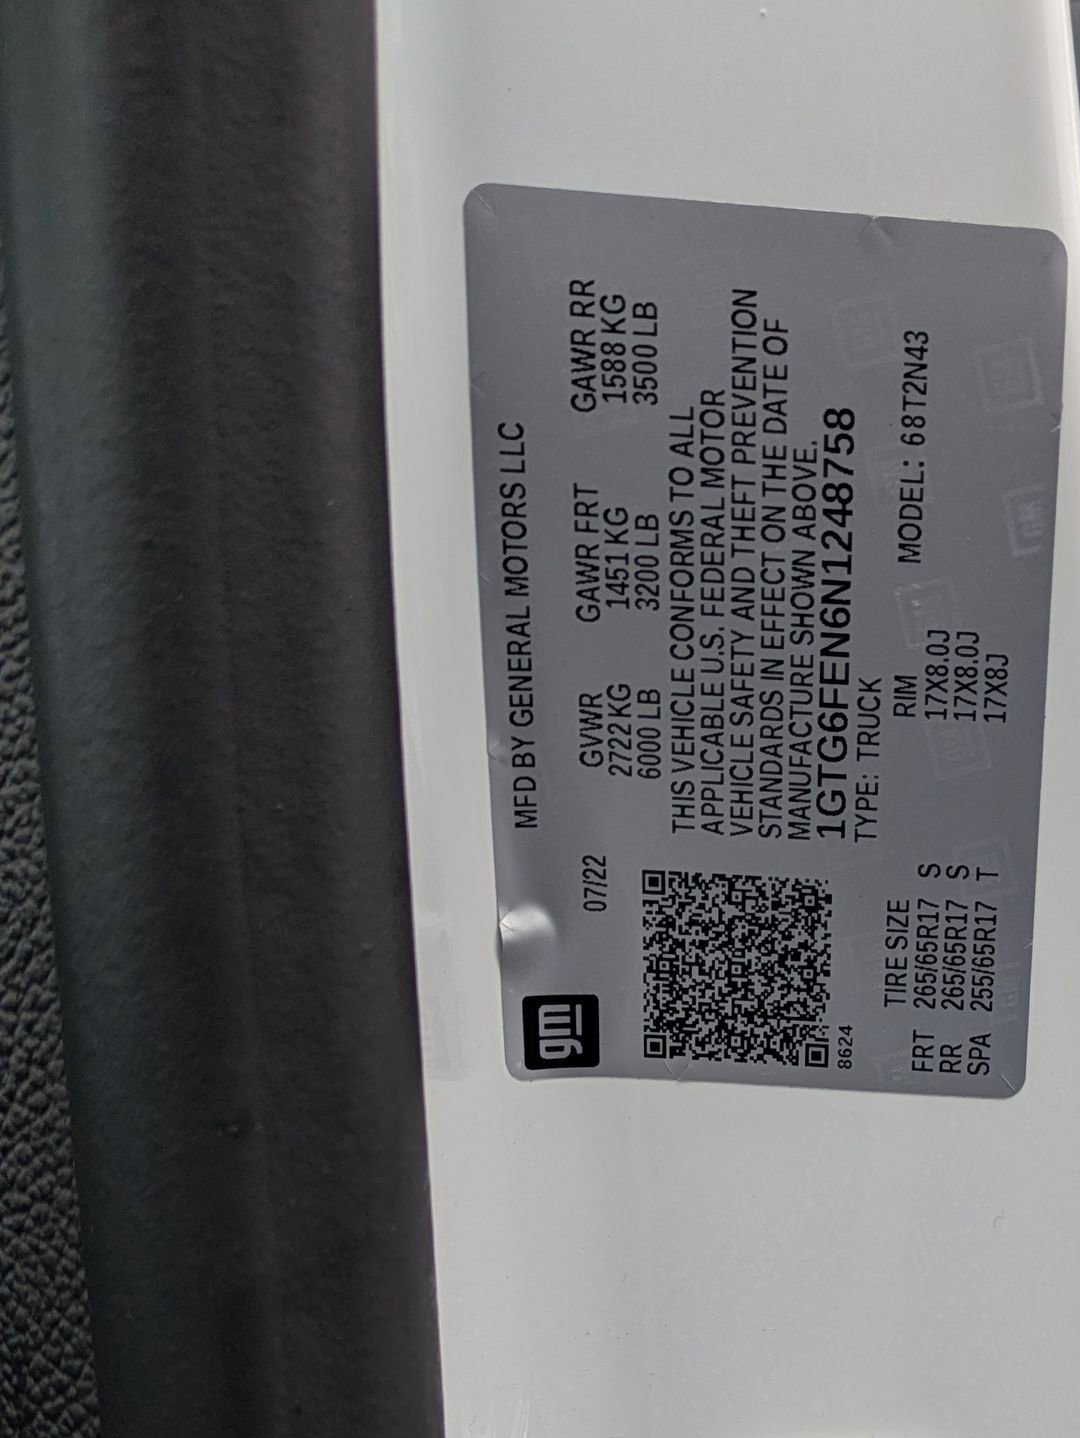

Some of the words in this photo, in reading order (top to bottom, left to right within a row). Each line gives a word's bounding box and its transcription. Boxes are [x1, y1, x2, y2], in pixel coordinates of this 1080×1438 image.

[569, 280, 595, 318] RR
[599, 294, 626, 335] KG
[632, 302, 658, 337] LB
[762, 318, 788, 356] OF
[570, 329, 597, 413] GAWR
[600, 341, 627, 404] 1588
[631, 344, 658, 406] 3500
[731, 289, 757, 465] PREVENTION
[900, 330, 929, 446] 68T2N43
[762, 364, 788, 435] DATE
[497, 422, 526, 474] LLC
[669, 406, 694, 458] ALL
[699, 390, 725, 489] MOTOR
[668, 467, 694, 503] TO
[762, 445, 787, 498] THE
[791, 441, 817, 541] ABOVE.
[573, 482, 599, 533] FRT
[603, 507, 629, 545] KG
[634, 514, 659, 546] LB
[731, 474, 756, 558] THEFT
[761, 505, 786, 543] ON
[897, 461, 925, 564] MODEL:
[499, 482, 529, 597] MOTORS
[700, 497, 725, 617] FEDERAL
[575, 544, 600, 622] GAWR
[604, 553, 630, 609] 1451
[634, 555, 660, 611] 3200
[668, 510, 694, 660] CONFORMS
[730, 567, 755, 621] AND
[760, 551, 785, 650] EFFECT
[789, 550, 816, 646] SHOWN
[699, 627, 725, 674] U.S.
[815, 408, 857, 840] 1GTG6FEN6N1248758
[505, 605, 534, 727] GENERAL
[730, 629, 755, 727] SAFETY
[760, 658, 784, 681] IN
[924, 630, 950, 720] 17X8.0J
[953, 631, 980, 722] 17X8.0J
[983, 654, 1009, 723] 17X8J
[606, 684, 632, 718] KG
[637, 689, 661, 720] LB
[670, 668, 695, 773] VEHICLE
[856, 678, 882, 762] TRUCK
[893, 675, 918, 717] RIM
[511, 736, 536, 768] BY
[578, 693, 604, 768] GVWR
[607, 723, 632, 777] 2722
[636, 727, 661, 779] 6000
[700, 682, 724, 835] APPLICABLE
[788, 653, 814, 840] MANUFACTURE
[730, 734, 754, 836] VEHICLE
[758, 690, 784, 839] STANDARDS
[513, 776, 538, 828] MFD
[670, 780, 695, 834] THIS
[854, 775, 879, 843] TYPE:
[582, 855, 608, 912] 07/22
[917, 863, 941, 878] S
[945, 865, 970, 880] S
[976, 867, 999, 881] T
[885, 900, 910, 950] SIZE
[913, 898, 940, 1009] 265/65R17
[941, 900, 968, 1011] 265/65R17
[970, 901, 997, 1012] 255/65R17
[884, 957, 908, 1008] TIRE
[837, 1025, 853, 1069] 8624
[911, 1029, 935, 1072] FRT
[939, 1044, 962, 1073] RR
[968, 1033, 991, 1076] SPA
